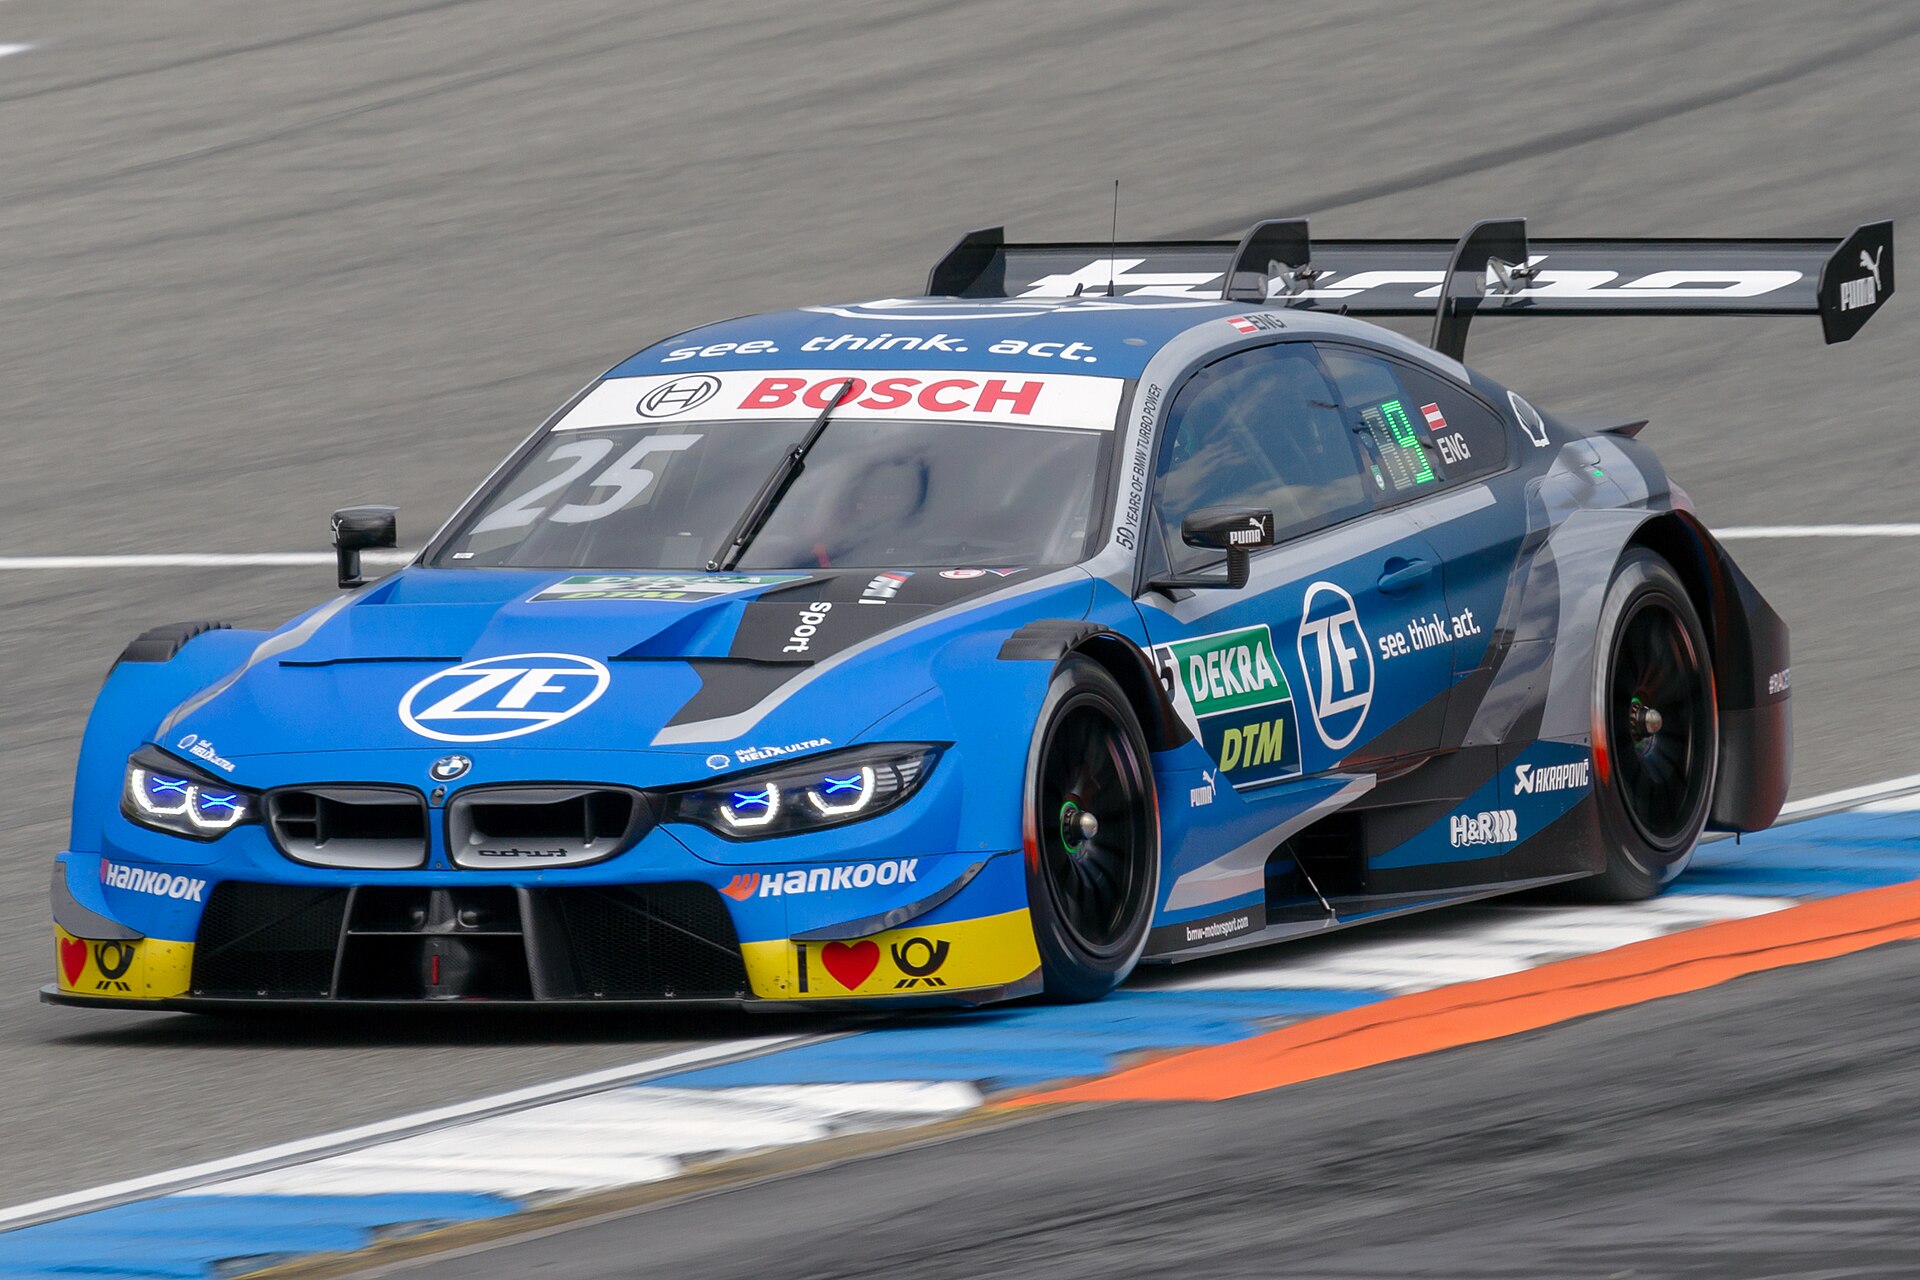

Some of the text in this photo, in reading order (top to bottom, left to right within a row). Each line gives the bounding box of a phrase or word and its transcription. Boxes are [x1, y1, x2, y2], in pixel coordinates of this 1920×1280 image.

[1840, 276, 1877, 311] PUMA
[1243, 313, 1288, 331] ENG
[660, 333, 1098, 364] see. think. act.
[737, 376, 1045, 415] BOSCH
[1116, 383, 1163, 551] 50 YEARS OF BMW TURBO POWER
[1436, 432, 1471, 465] ENG
[468, 433, 705, 536] 25
[1229, 529, 1261, 545] PUMA
[559, 591, 687, 600] DTM
[782, 601, 832, 653] sport
[1378, 607, 1481, 661] see. think. act.
[1189, 640, 1278, 703] DEKRA
[1299, 609, 1371, 719] ZF
[412, 665, 604, 722] ZF
[738, 738, 832, 763] HELIX ULTRA
[1219, 718, 1284, 773] DTM
[1186, 916, 1249, 942] bmw-motorsport.com
